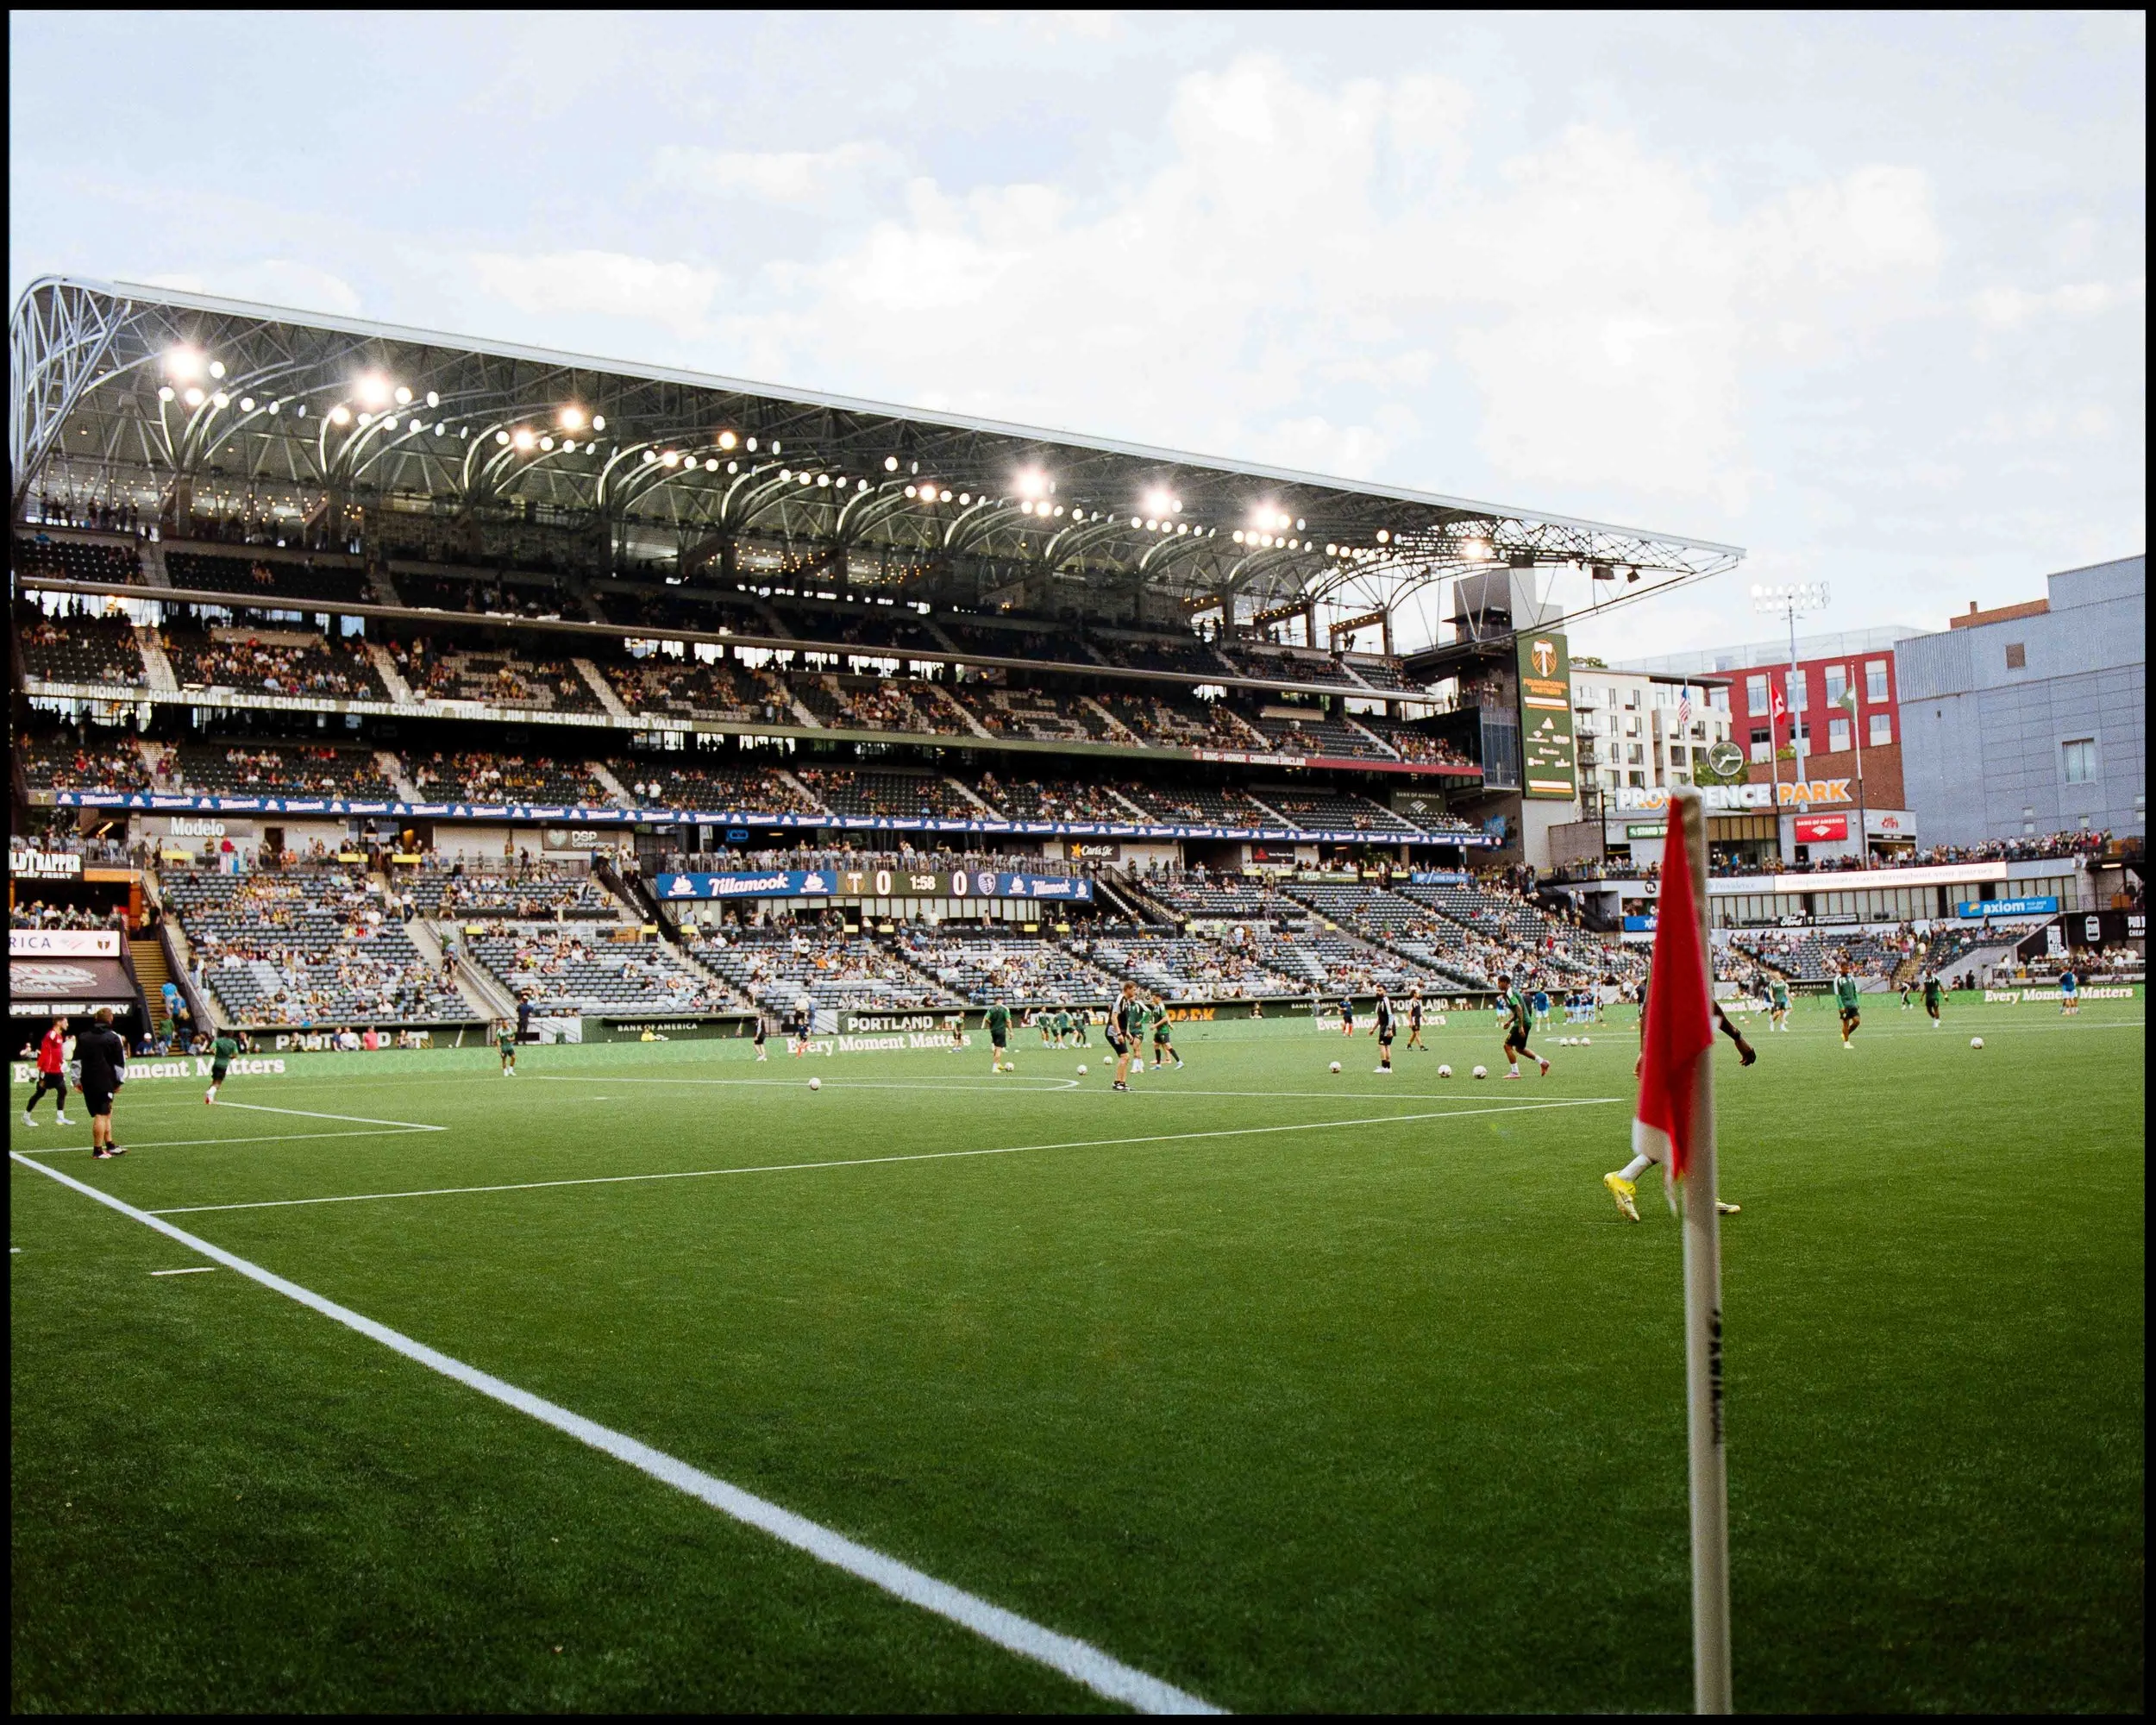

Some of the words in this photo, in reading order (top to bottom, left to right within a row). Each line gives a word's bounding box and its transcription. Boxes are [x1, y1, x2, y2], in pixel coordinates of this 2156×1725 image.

[44, 682, 77, 697] RING
[89, 685, 135, 700] HONOR
[144, 689, 184, 705] JOHN
[229, 693, 271, 709] CLIVE
[273, 696, 336, 712] CHARLES
[346, 699, 388, 715] JIMMY
[391, 702, 445, 718] CONWAY
[454, 706, 500, 721] TIMBER
[503, 709, 525, 723] JIM
[532, 711, 562, 724] MICK
[564, 713, 605, 728] HOBAN
[613, 716, 648, 730] DIEGO
[651, 718, 693, 732] VALERI
[1616, 784, 1772, 812] PROVENCE
[1777, 779, 1853, 806] PARK
[171, 817, 225, 837] Modelo
[572, 831, 598, 842] DSP
[9, 851, 27, 871] LD
[26, 849, 80, 873] TRAPPER
[708, 873, 789, 896] Tillamook
[876, 870, 891, 894] 0
[910, 875, 936, 890] 1:58
[953, 870, 967, 895] 0
[1031, 880, 1070, 896] Tillamook
[1984, 900, 2025, 914] axiom
[9, 937, 51, 949] RICA
[1984, 989, 2020, 1004] Every
[2079, 987, 2134, 999] Matters
[9, 1004, 49, 1015] PPER
[848, 1016, 933, 1032] PORTLAND
[787, 1038, 834, 1056] Eery
[838, 1036, 906, 1051] Moment
[910, 1033, 971, 1048] Mattes
[196, 1057, 285, 1077] Mtters
